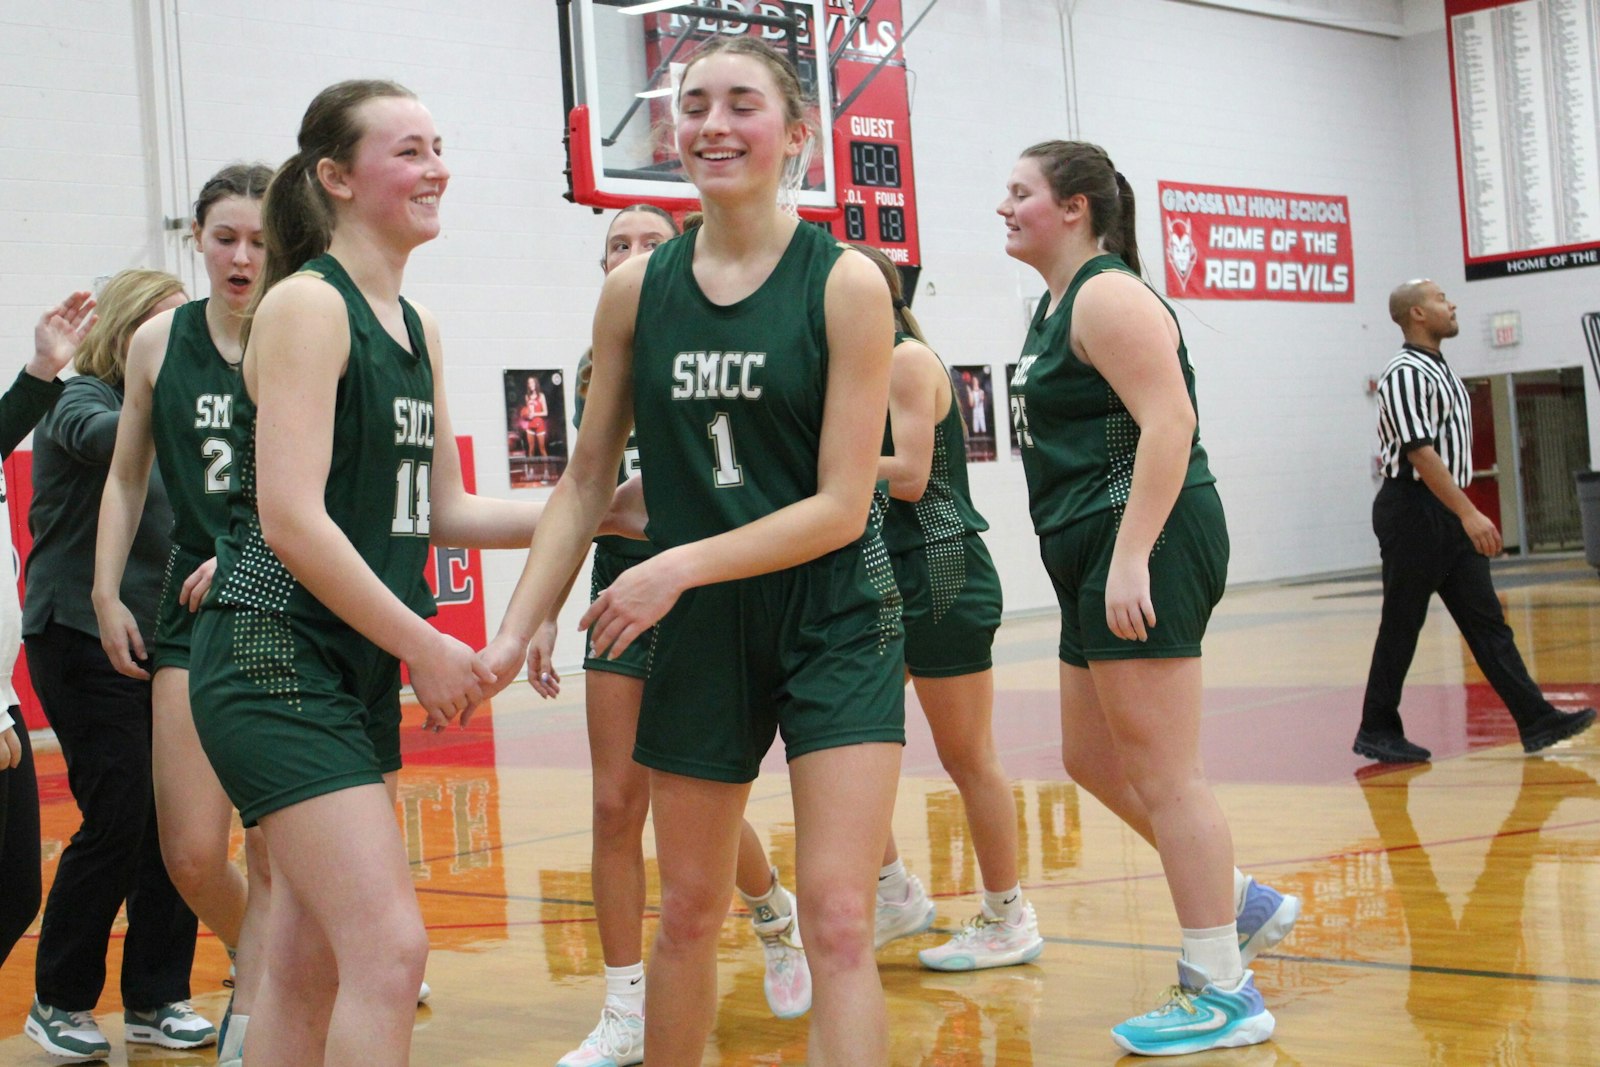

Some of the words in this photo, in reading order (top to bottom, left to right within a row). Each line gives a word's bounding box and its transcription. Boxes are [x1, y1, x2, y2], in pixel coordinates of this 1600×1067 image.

[851, 115, 895, 139] GUEST
[875, 191, 905, 207] FOULS
[1248, 196, 1288, 221] HIGH
[1289, 200, 1347, 224] SCHOOL
[1209, 225, 1265, 251] HOME
[1270, 229, 1298, 254] OF
[1302, 231, 1338, 255] THE
[1507, 257, 1548, 273] HOME
[1549, 254, 1569, 267] OF
[1570, 250, 1599, 264] THE
[1205, 259, 1257, 291] RED
[1265, 261, 1350, 294] DEVILS
[671, 351, 767, 401] SMCC
[707, 411, 745, 489] 1
